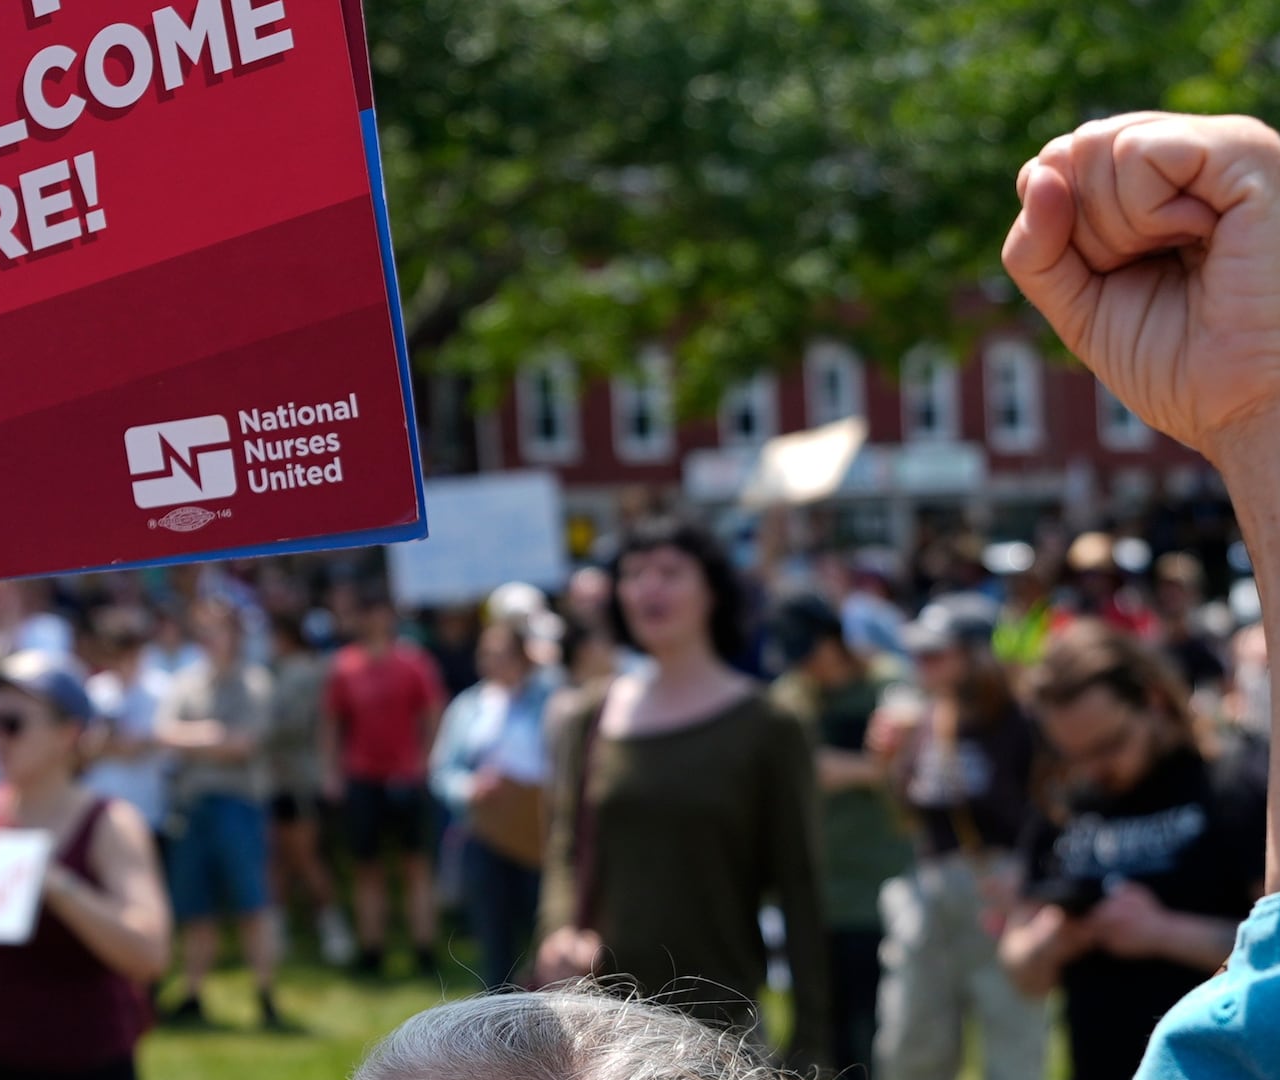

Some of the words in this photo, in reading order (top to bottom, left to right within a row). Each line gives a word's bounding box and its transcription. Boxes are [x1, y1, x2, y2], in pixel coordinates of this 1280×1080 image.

[238, 393, 359, 434] National
[243, 432, 340, 464] Nurses
[247, 457, 343, 494] United
